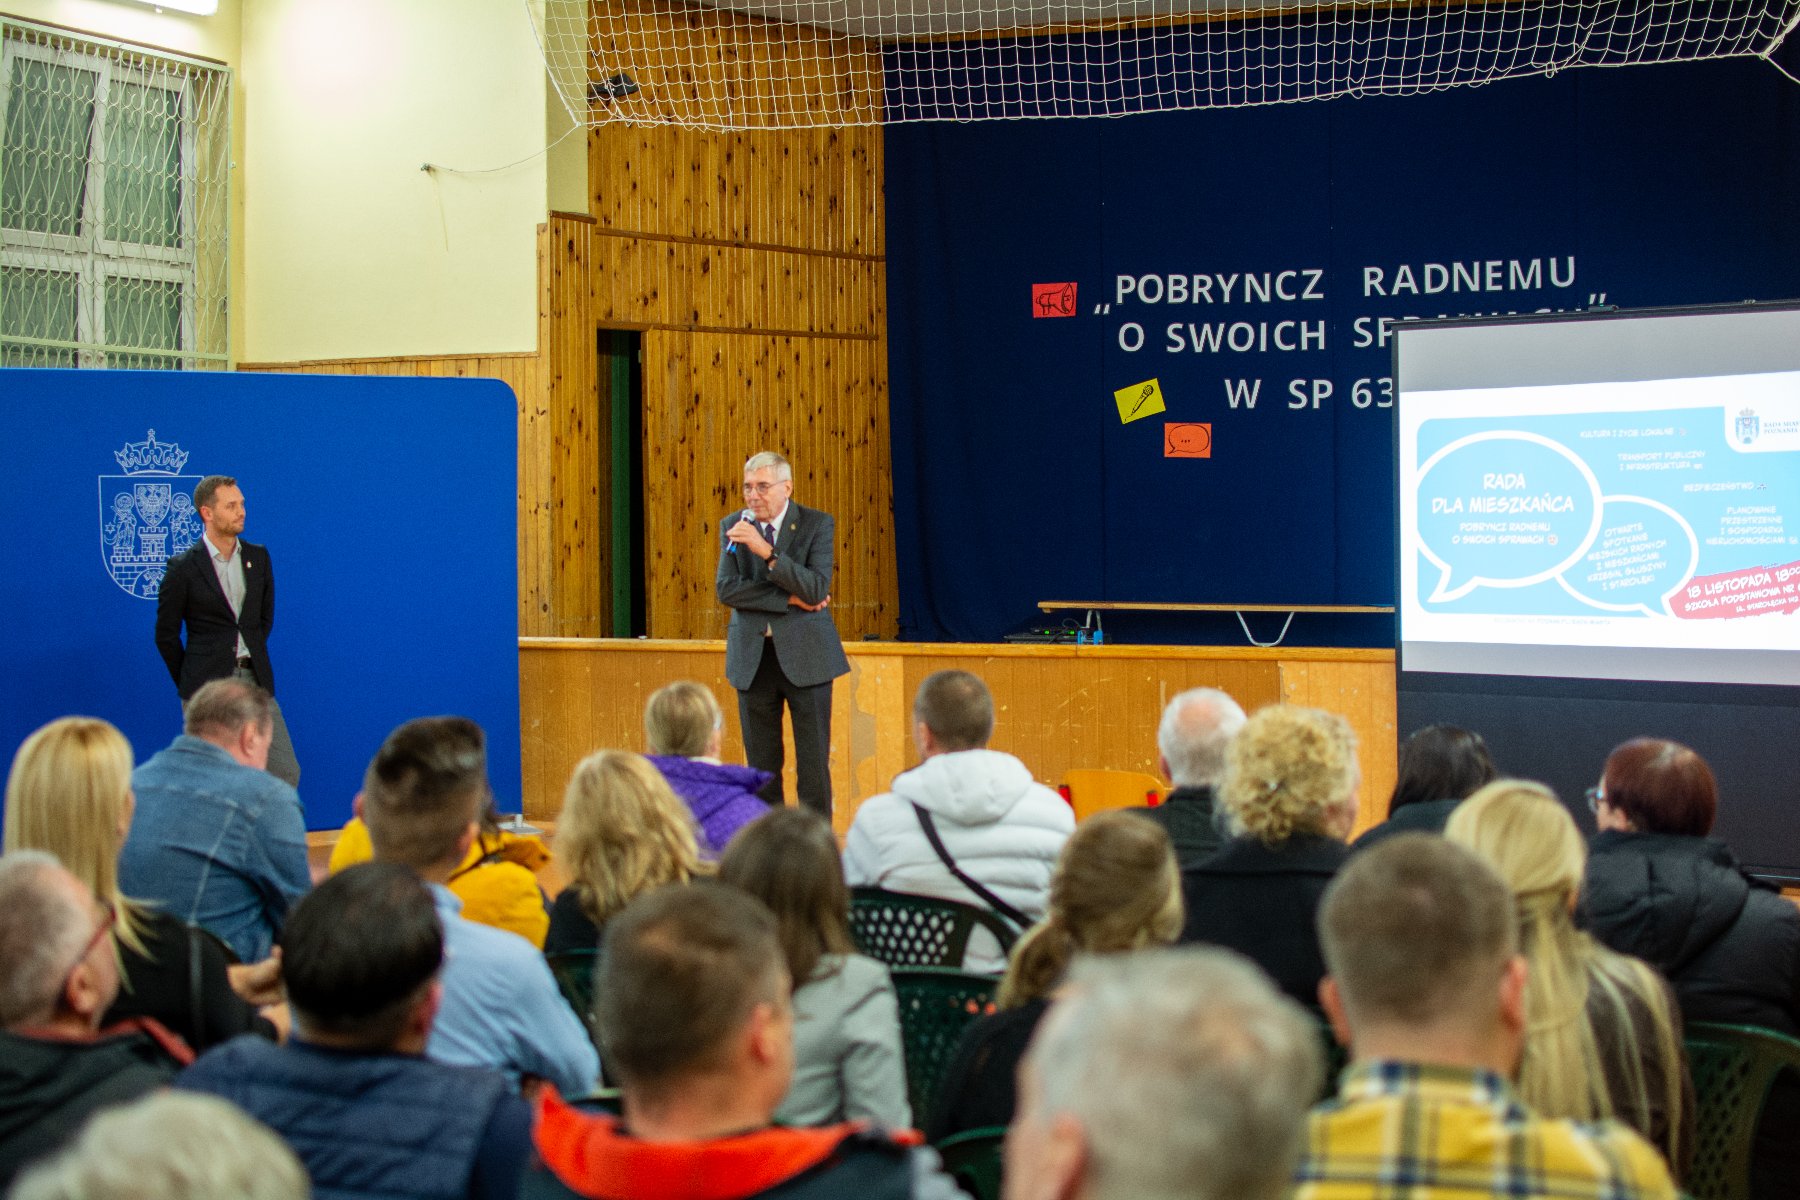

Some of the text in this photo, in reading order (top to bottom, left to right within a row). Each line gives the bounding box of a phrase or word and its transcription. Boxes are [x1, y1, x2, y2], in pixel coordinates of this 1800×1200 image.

[1363, 256, 1576, 298] RADNEMU
[1118, 321, 1145, 352] O
[1165, 320, 1327, 354] SWOICH
[1224, 378, 1262, 409] W
[1288, 379, 1334, 410] SP
[1617, 450, 1706, 462] TRANSPORT PUBLICZNY
[1483, 472, 1526, 491] RADA
[1431, 492, 1575, 514] DLA MIESZKAŃCA
[1459, 521, 1551, 533] POBRYNCZ RADNEMU
[1604, 522, 1644, 538] OTWARTE
[1452, 534, 1545, 545] O SWOICH SPRAWACH
[1630, 539, 1667, 554] RADNYCH
[1686, 585, 1702, 598] 18
[1704, 572, 1772, 596] LISTOPADA
[1684, 597, 1719, 612] SZKOŁA
[1720, 586, 1781, 605] PODSTAWOWA
[1782, 584, 1795, 594] NR
